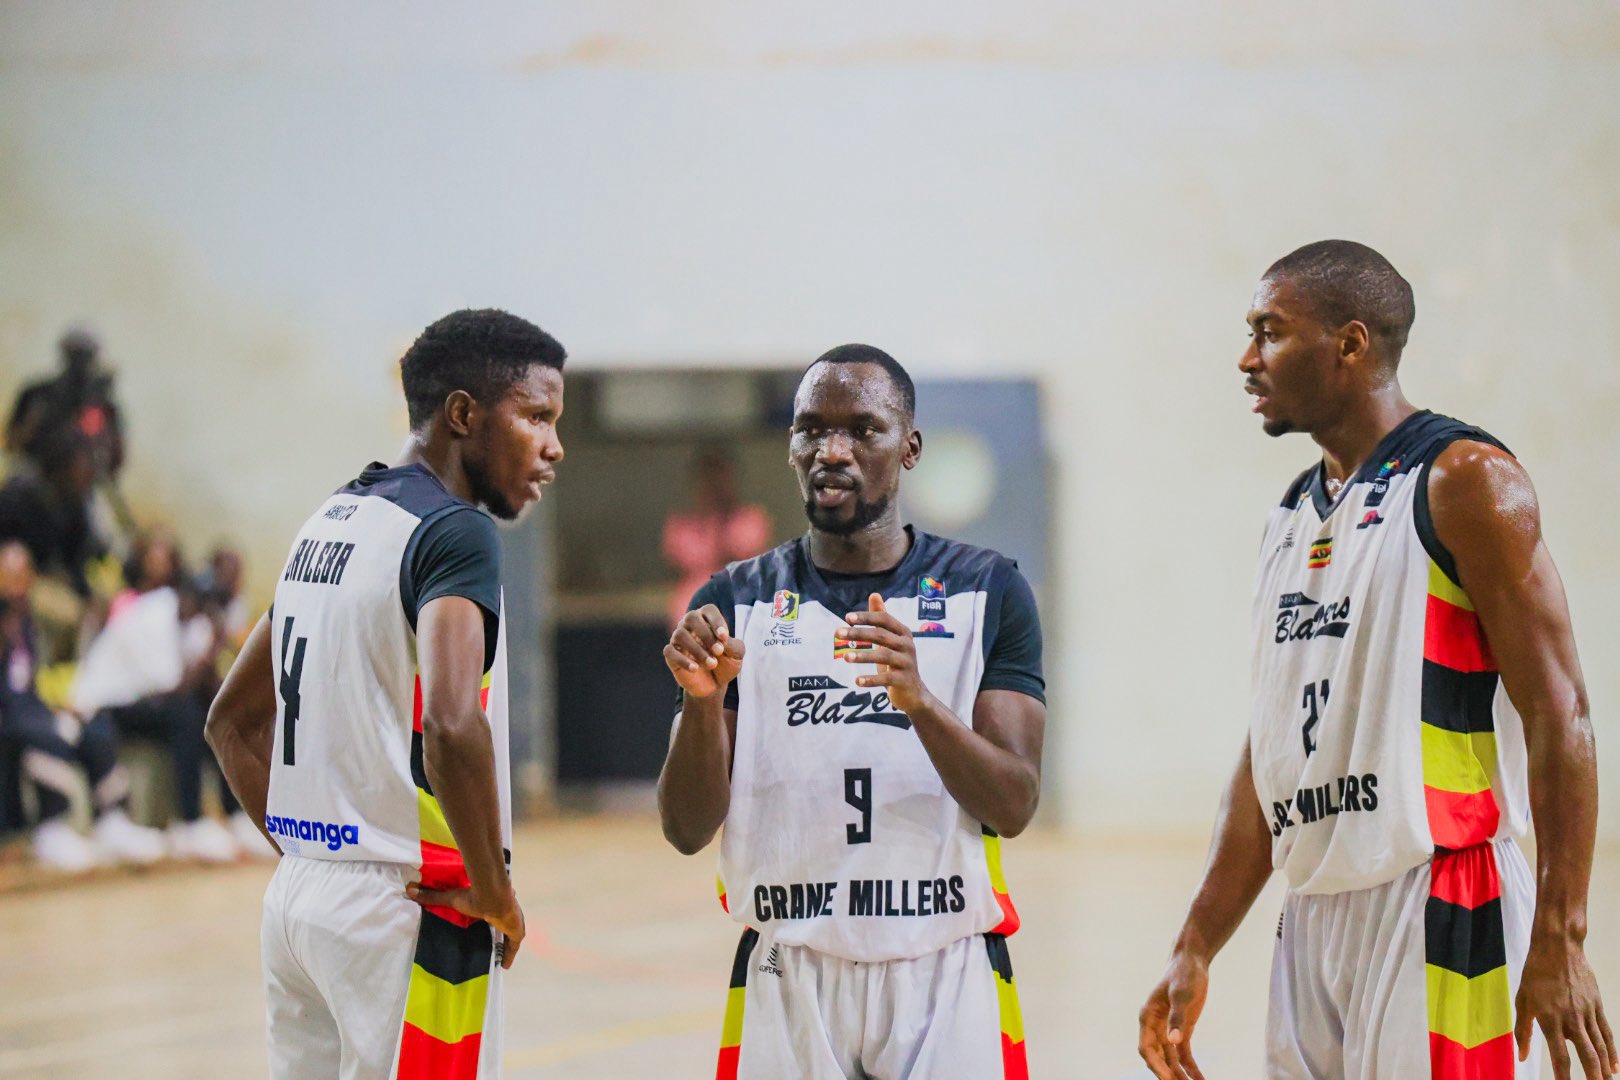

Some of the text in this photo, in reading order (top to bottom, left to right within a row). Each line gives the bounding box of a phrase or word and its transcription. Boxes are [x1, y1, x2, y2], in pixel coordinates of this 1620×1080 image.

[922, 600, 942, 610] FIBA
[763, 638, 802, 647] GOFERE
[279, 616, 308, 766] 4
[791, 678, 829, 688] NAM
[786, 690, 913, 731] Blaze
[844, 768, 872, 844] 9
[266, 814, 359, 851] samanga
[754, 875, 966, 922] CRANE MILLERS
